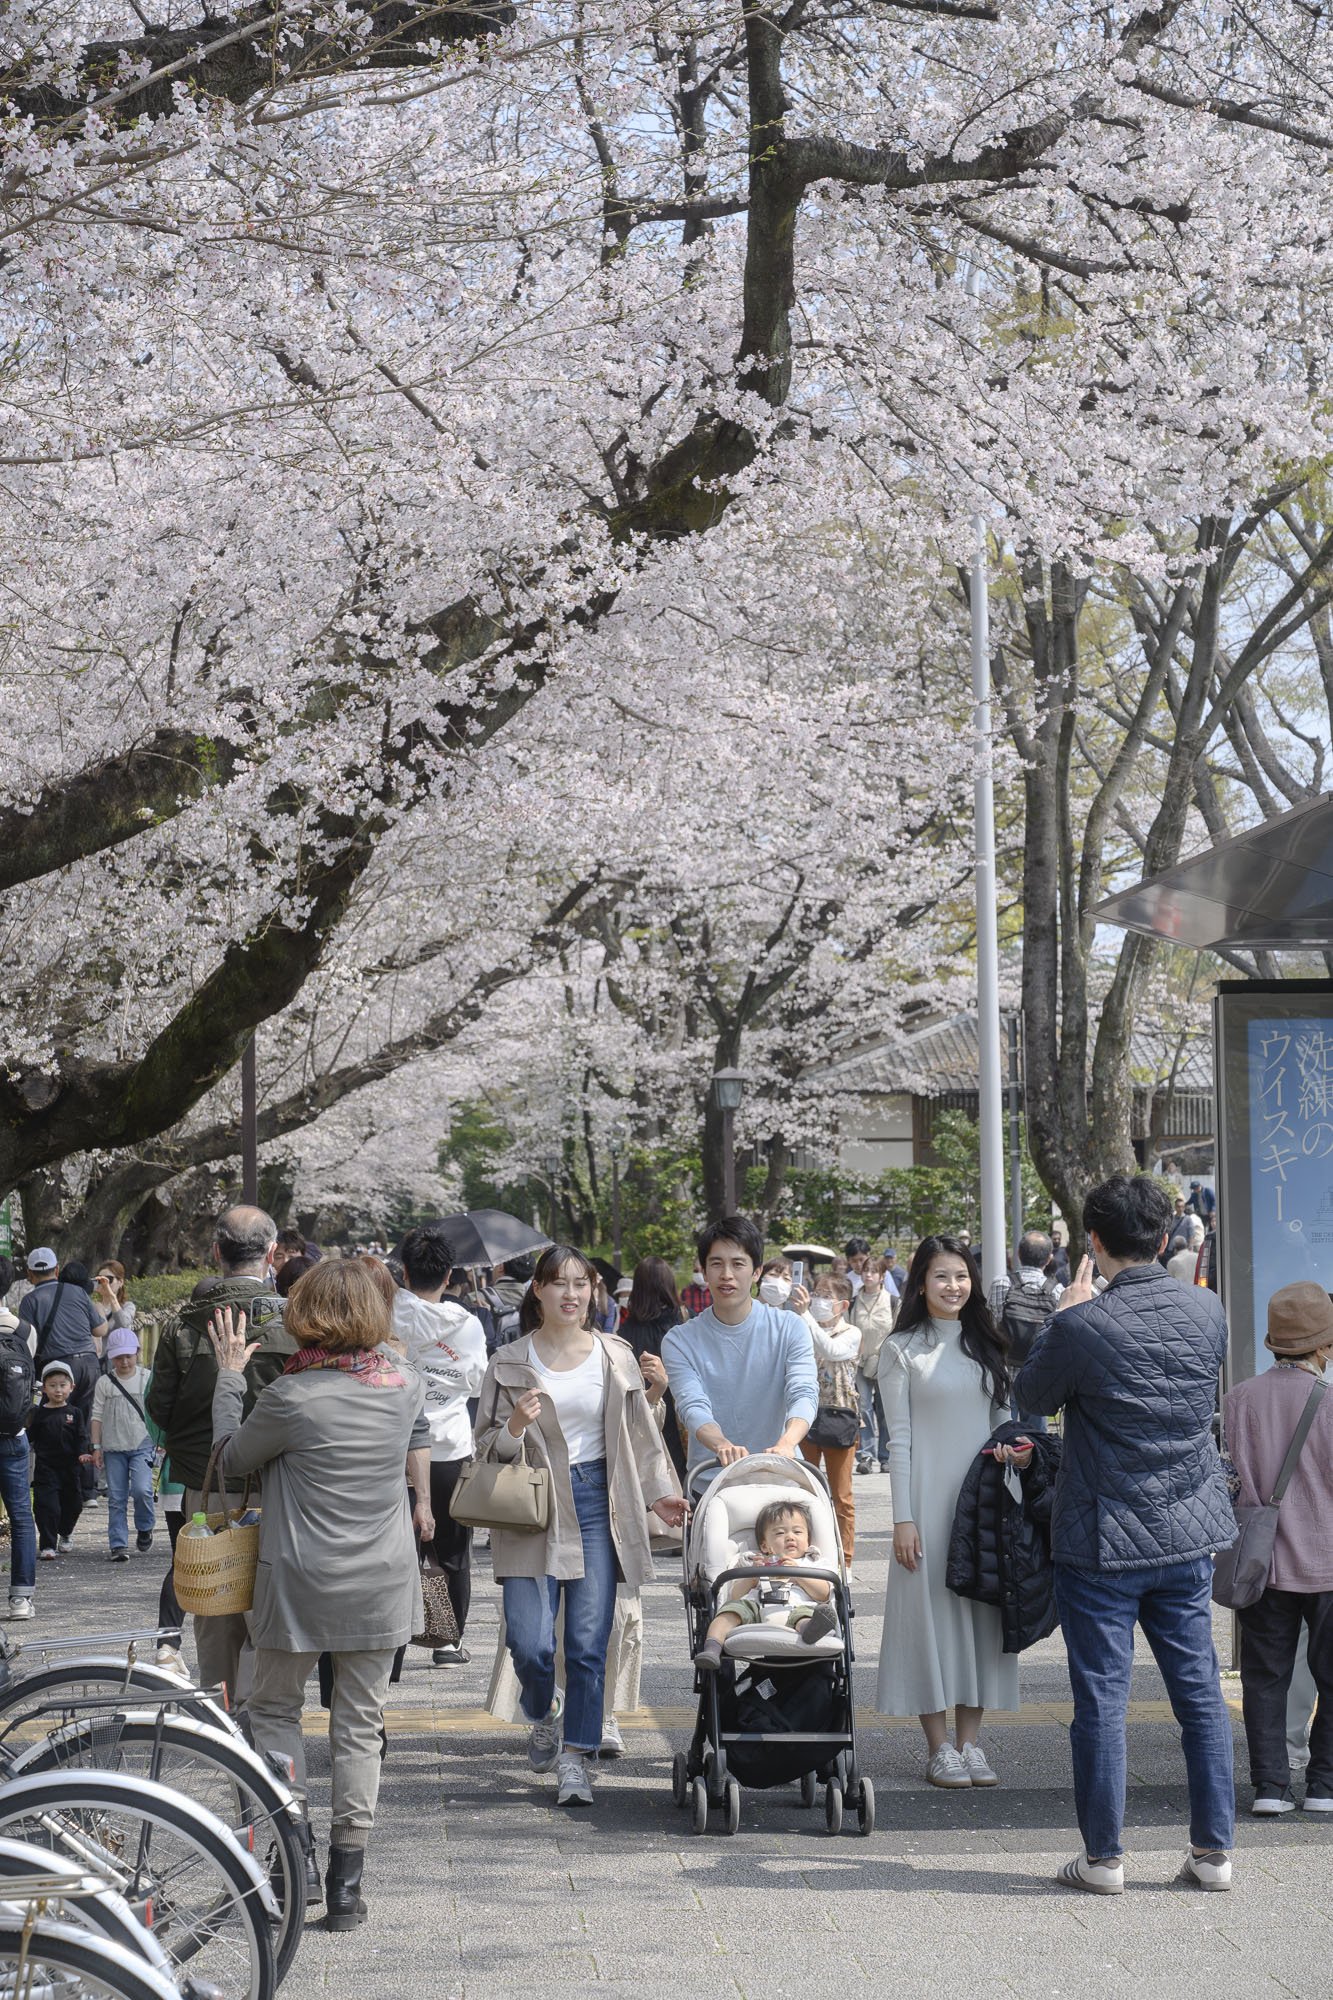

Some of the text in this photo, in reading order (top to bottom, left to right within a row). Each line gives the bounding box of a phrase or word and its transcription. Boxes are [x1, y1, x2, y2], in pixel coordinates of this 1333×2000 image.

[1295, 1031, 1333, 1159] 洗練の
[425, 1391, 450, 1405] City
